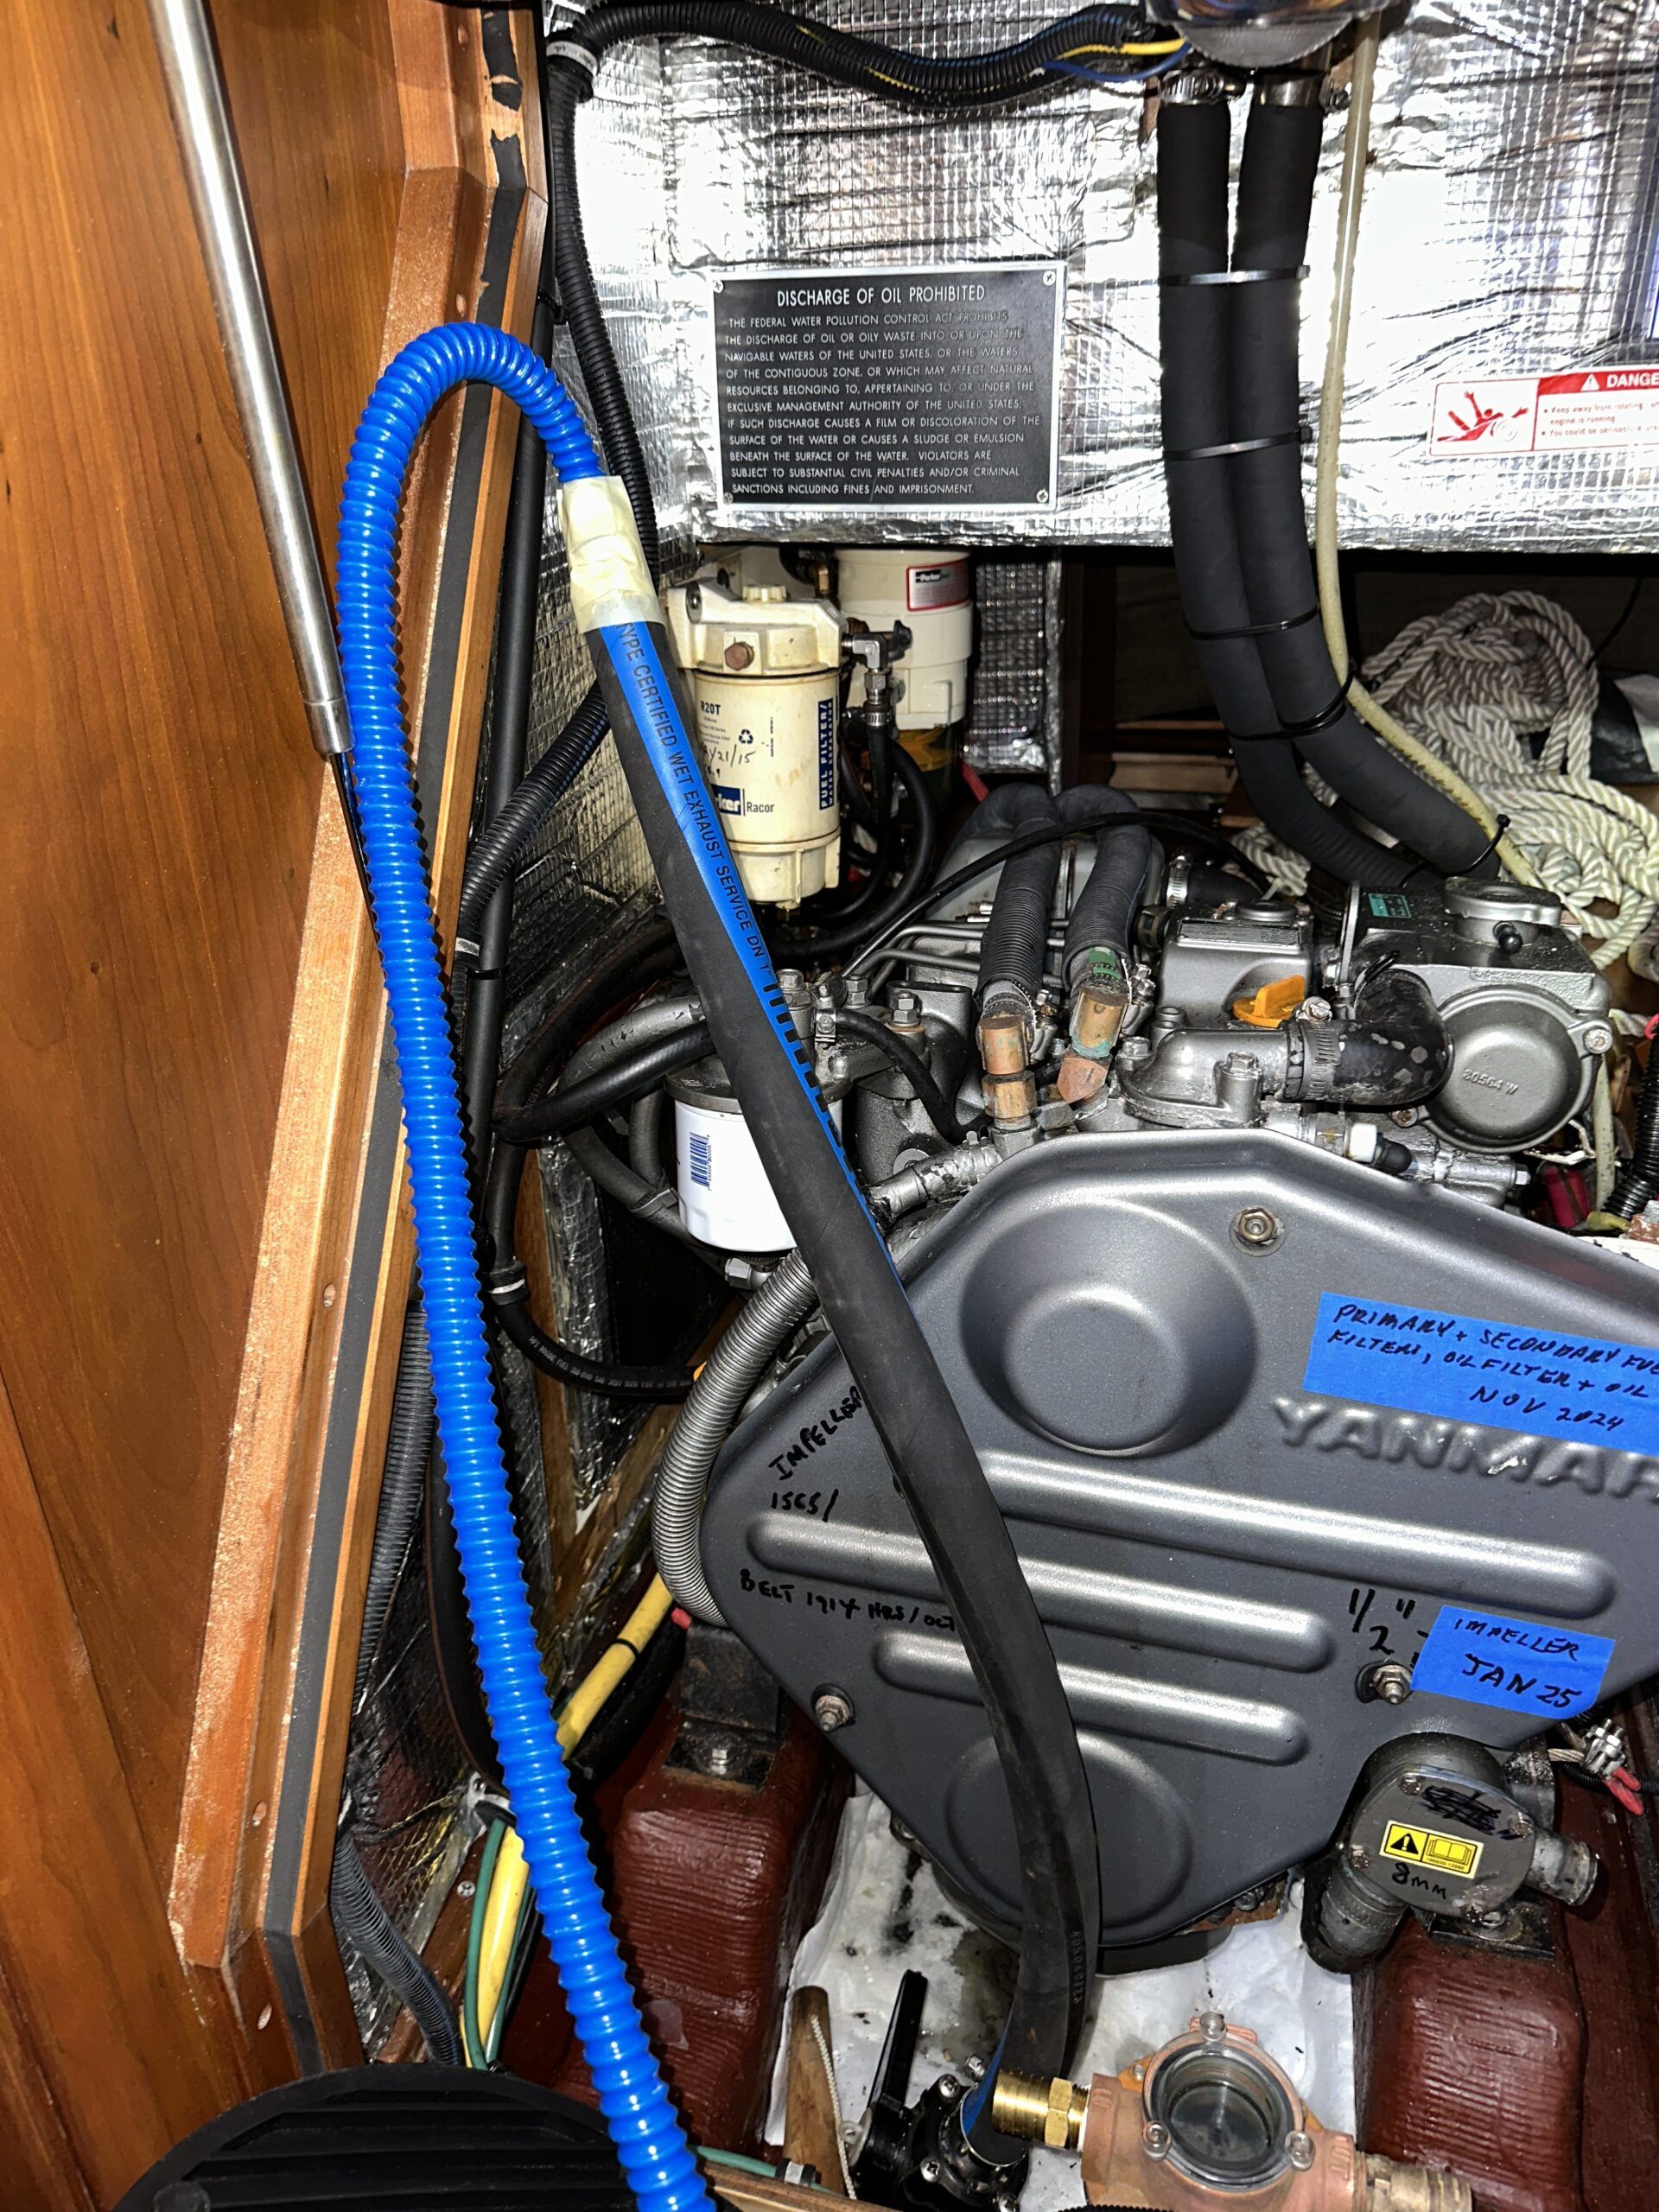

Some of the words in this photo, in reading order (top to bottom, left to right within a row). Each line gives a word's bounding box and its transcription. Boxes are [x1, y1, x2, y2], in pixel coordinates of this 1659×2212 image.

[778, 289, 849, 307] DISCHARGE
[857, 288, 874, 304] OF
[881, 288, 901, 303] OIL
[909, 285, 985, 302] PROHIBITED
[729, 318, 745, 327] THE
[750, 317, 786, 327] FEDERAL
[791, 316, 821, 326] WATER
[826, 315, 879, 326] POLLUTION
[884, 314, 929, 324] CONTROL
[936, 313, 953, 322] ACT
[959, 310, 1008, 321] PROHIBITS
[726, 334, 741, 345] THE
[747, 334, 798, 345] DISCHARGE
[804, 334, 816, 343] OF
[821, 334, 835, 343] OIL
[841, 333, 854, 342] OR
[859, 332, 879, 342] OILY
[884, 331, 915, 341] WASTE
[921, 331, 945, 340] INTO
[950, 329, 964, 339] OR
[969, 329, 999, 340] UPON
[1005, 328, 1024, 340] THE
[725, 352, 774, 362] NAVIGABLE
[779, 351, 814, 361] WATERS
[819, 351, 832, 359] OF
[837, 350, 854, 359] THE
[859, 349, 893, 359] UNITED
[938, 348, 951, 358] OR
[957, 348, 975, 357] THE
[980, 347, 1018, 356] WATERS
[726, 370, 738, 379] OF
[744, 369, 760, 378] THE
[765, 368, 828, 378] CONTIGUOUS
[868, 367, 880, 376] OR
[887, 366, 920, 376] WHICH
[925, 365, 945, 375] MAY
[950, 365, 984, 374] AFFECT
[990, 364, 1033, 374] NATURAL
[726, 385, 778, 396] RESOURCES
[784, 385, 840, 395] BELONGING
[864, 383, 933, 394] APPERTAINING
[959, 383, 972, 391] OR
[978, 382, 1010, 391] UNDER
[1017, 381, 1034, 391] THE
[728, 402, 772, 412] EXCLUSIVE
[777, 401, 843, 412] MANAGEMENT
[849, 400, 901, 411] AUTHORITY
[906, 400, 918, 410] OF
[925, 400, 942, 410] THE
[948, 399, 983, 410] UNITED
[728, 419, 734, 429] IF
[740, 419, 764, 429] SUCH
[768, 418, 819, 429] DISCHARGE
[824, 418, 861, 428] CAUSES
[865, 418, 871, 427] A
[876, 418, 896, 427] FILM
[901, 417, 915, 427] OR
[920, 416, 998, 427] DISCOLORATION
[1003, 416, 1016, 426] OF
[1023, 416, 1039, 425] THE
[729, 435, 766, 445] SURFACE
[771, 435, 782, 445] OF
[788, 435, 804, 445] THE
[809, 435, 838, 445] WATER
[843, 435, 856, 444] OR
[861, 435, 897, 444] CAUSES
[902, 435, 909, 443] A
[913, 435, 950, 444] SLUDGE
[955, 434, 969, 443] OR
[974, 434, 1024, 442] EMULSION
[730, 452, 769, 461] BENEATH
[774, 452, 790, 461] THE
[795, 452, 832, 461] SURFACE
[837, 452, 849, 461] OF
[855, 452, 872, 461] THE
[877, 451, 909, 461] WATER.
[918, 451, 969, 461] VIOLATORS
[975, 450, 991, 460] ARE
[731, 468, 766, 478] SUBJECT
[772, 468, 785, 477] TO
[790, 468, 845, 478] SUBSTANTIAL
[850, 468, 872, 477] CIVIL
[877, 467, 925, 478] PENALTIES
[930, 467, 968, 477] AND/OR
[974, 467, 1019, 476] CRIMINAL
[733, 484, 784, 494] SANCTIONS
[788, 485, 839, 494] INCLUDING
[844, 485, 869, 494] FINES
[874, 485, 894, 494] AND
[899, 484, 974, 494] IMPRISONMENT.
[633, 665, 677, 747] CERTIFIED
[668, 751, 694, 785] WET
[683, 791, 725, 861] EXHAUST
[716, 865, 753, 931] SERVICE
[747, 935, 765, 958] DN
[747, 802, 774, 813] Racor
[1333, 1304, 1456, 1337] PRIMARY
[1479, 1329, 1621, 1363] SECONDARY
[1444, 1351, 1476, 1368] OIL
[1481, 1359, 1571, 1387] FILTER
[1605, 1383, 1649, 1397] OIL
[1470, 1386, 1547, 1414] NOV
[1556, 1408, 1624, 1431] 2024
[768, 1386, 862, 1480] IMPELLER
[741, 1569, 794, 1603] BELT
[1454, 1618, 1580, 1662] IMPELLER
[1462, 1653, 1537, 1694] JAN
[1536, 1685, 1582, 1707] 25
